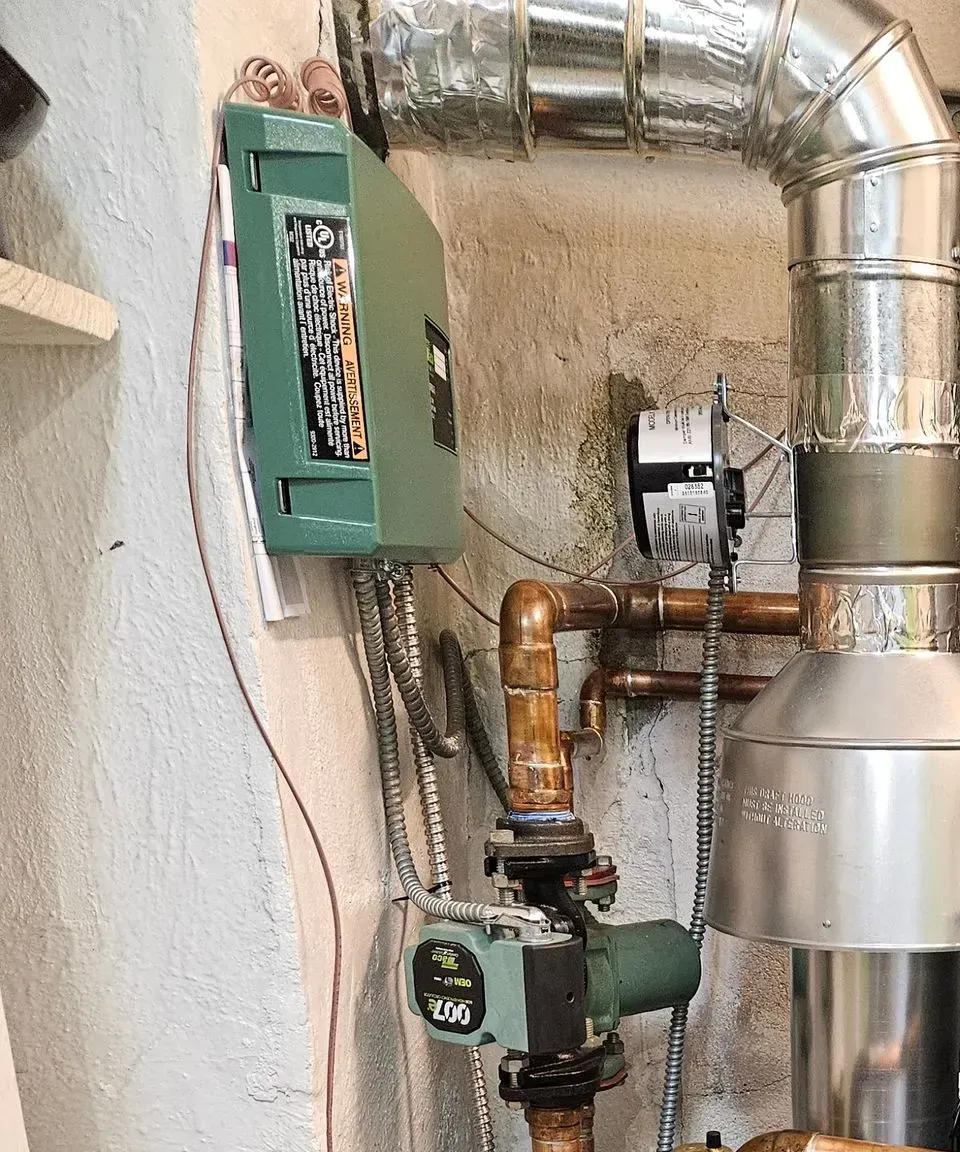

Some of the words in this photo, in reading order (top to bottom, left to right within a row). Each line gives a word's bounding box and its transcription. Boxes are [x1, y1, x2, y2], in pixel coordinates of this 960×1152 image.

[305, 225, 313, 247] LISTED
[299, 258, 307, 271] par
[307, 259, 317, 283] Risque
[301, 272, 309, 288] plus
[311, 284, 318, 294] de
[327, 286, 336, 311] Electric
[330, 313, 338, 333] Shock
[324, 333, 334, 371] Disconnect
[332, 340, 340, 354] This
[333, 355, 342, 377] device
[313, 382, 323, 409] Coupez
[329, 381, 337, 403] power
[335, 386, 345, 414] supplied
[345, 359, 362, 440] AVERTISSEMENT
[332, 404, 340, 425] before
[340, 415, 347, 424] by
[333, 427, 343, 457] servicing.
[760, 788, 785, 801] DRAFT
[790, 792, 813, 806] HOOD
[743, 798, 758, 809] MUST
[762, 803, 772, 812] BE
[775, 804, 825, 821] INSTALLED
[774, 816, 827, 835] ALTERATION
[454, 977, 471, 987] OEM
